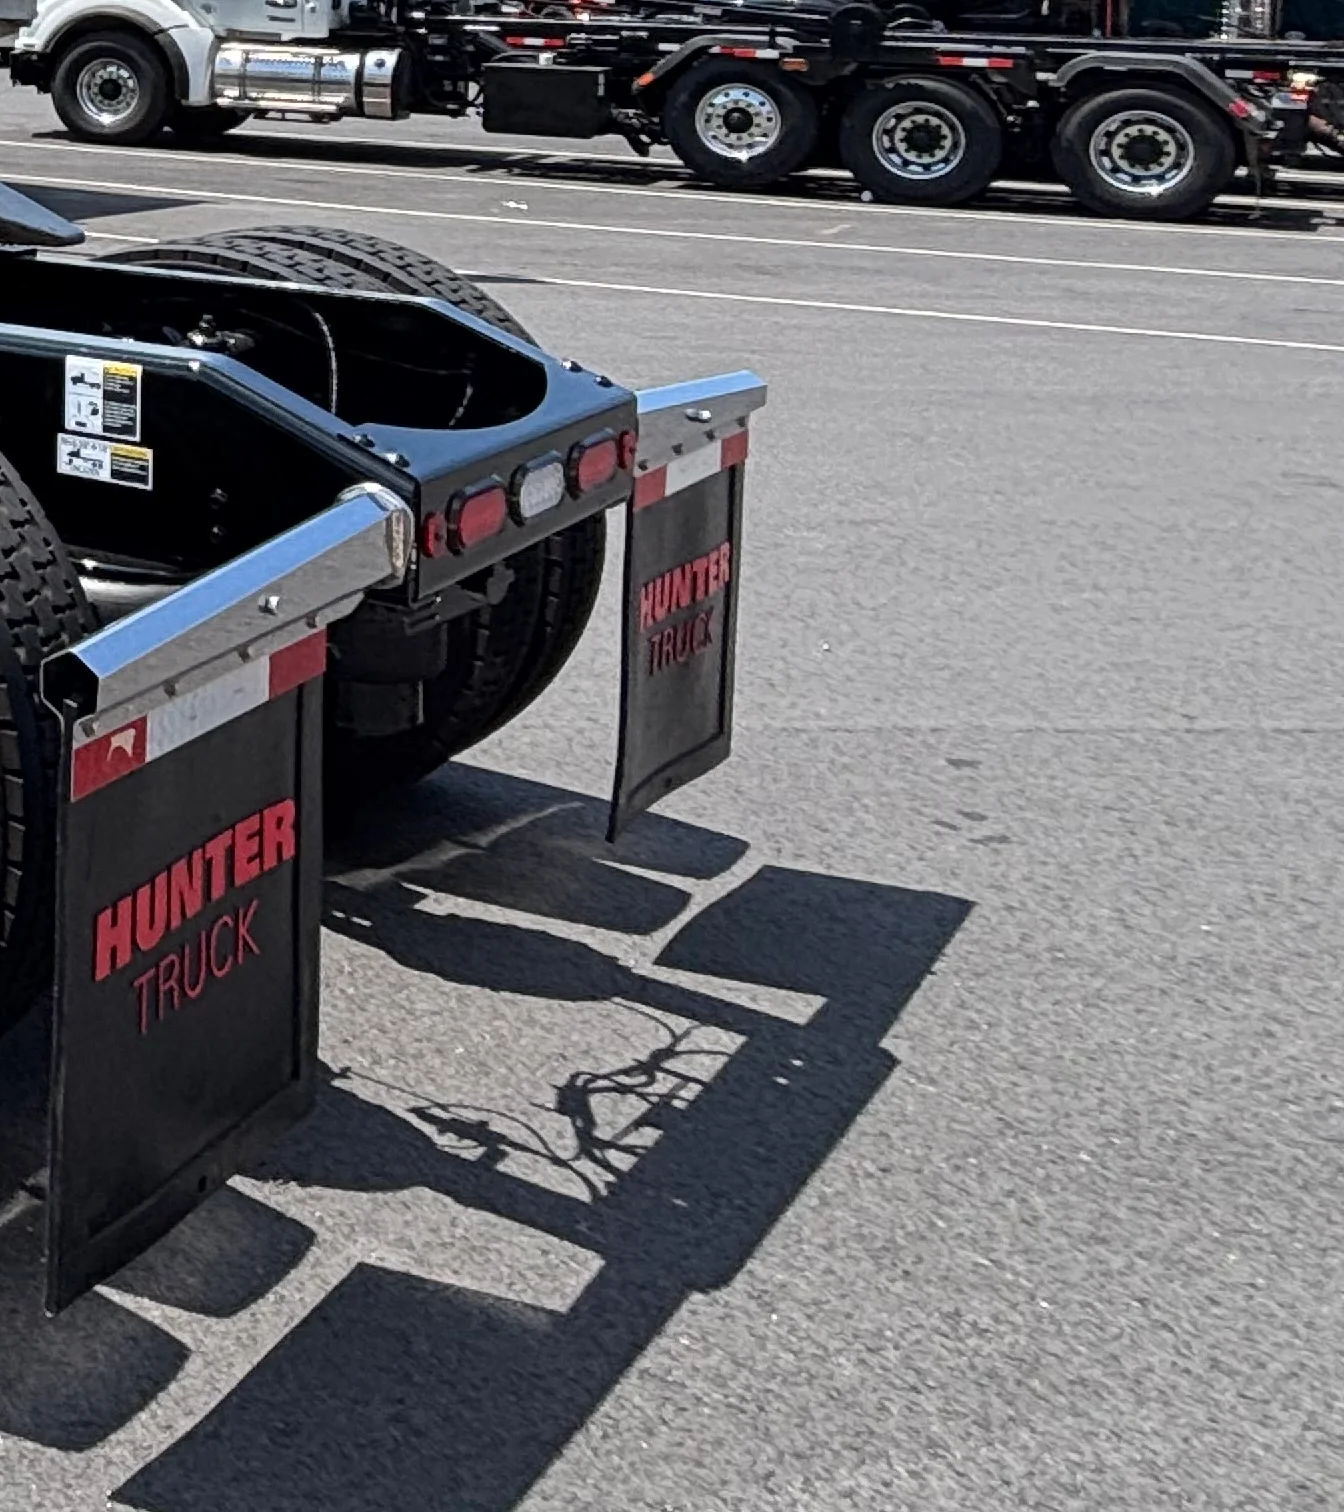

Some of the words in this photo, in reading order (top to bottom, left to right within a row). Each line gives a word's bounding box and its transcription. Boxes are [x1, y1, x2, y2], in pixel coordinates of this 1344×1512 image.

[640, 541, 730, 632] HUNTER
[647, 607, 714, 676] TRUCK
[94, 798, 296, 982] HUNTER
[132, 898, 260, 1035] TRUCK
